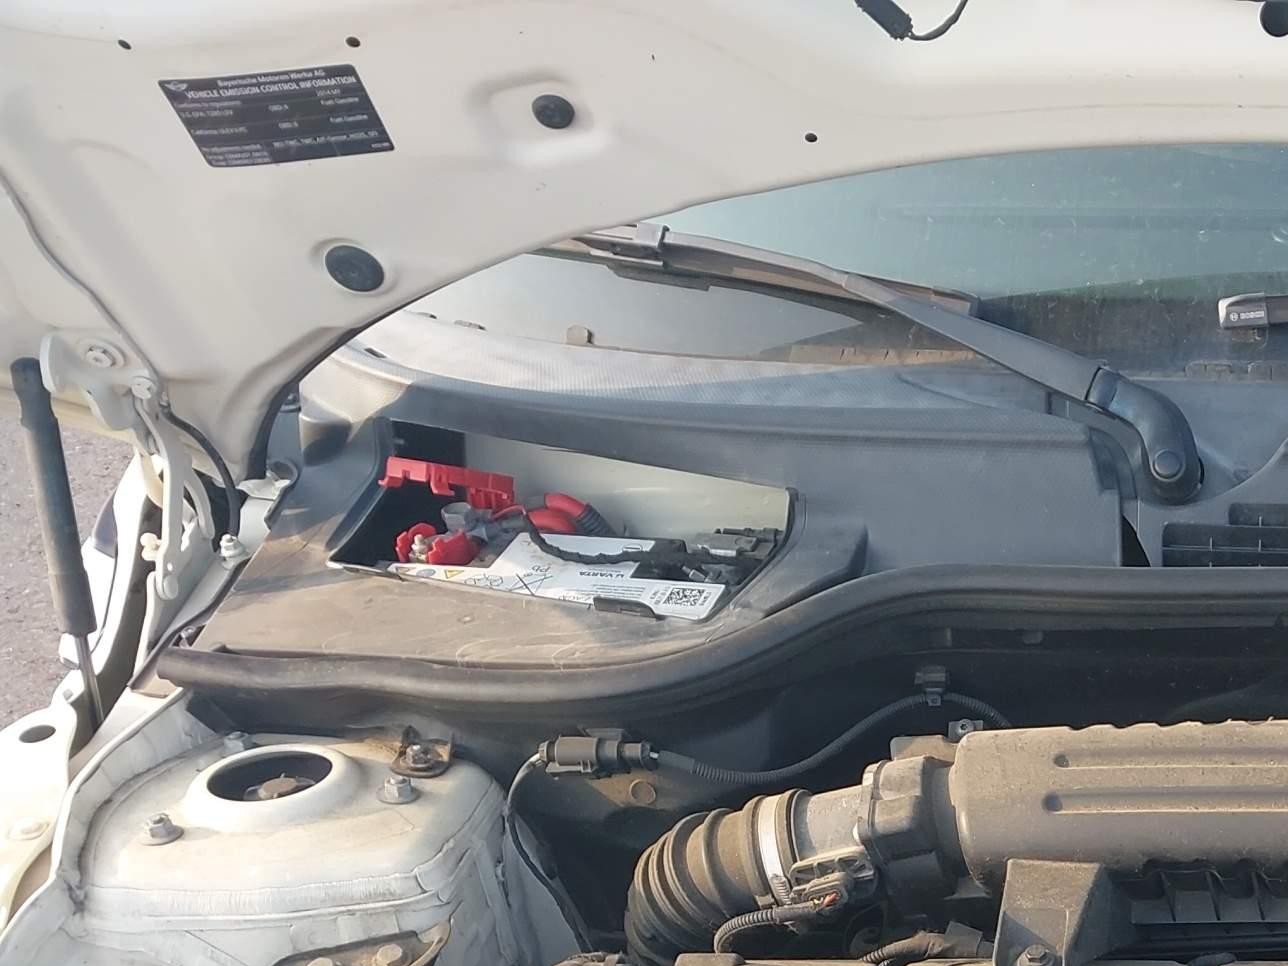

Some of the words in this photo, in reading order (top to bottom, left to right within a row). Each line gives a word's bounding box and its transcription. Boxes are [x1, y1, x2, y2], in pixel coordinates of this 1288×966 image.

[313, 68, 325, 77] AG
[185, 87, 218, 99] VEHICLE
[219, 85, 260, 97] EMISSION
[260, 81, 299, 94] CONTROL
[299, 75, 356, 90] INFORMATION
[579, 570, 614, 578] VARTA
